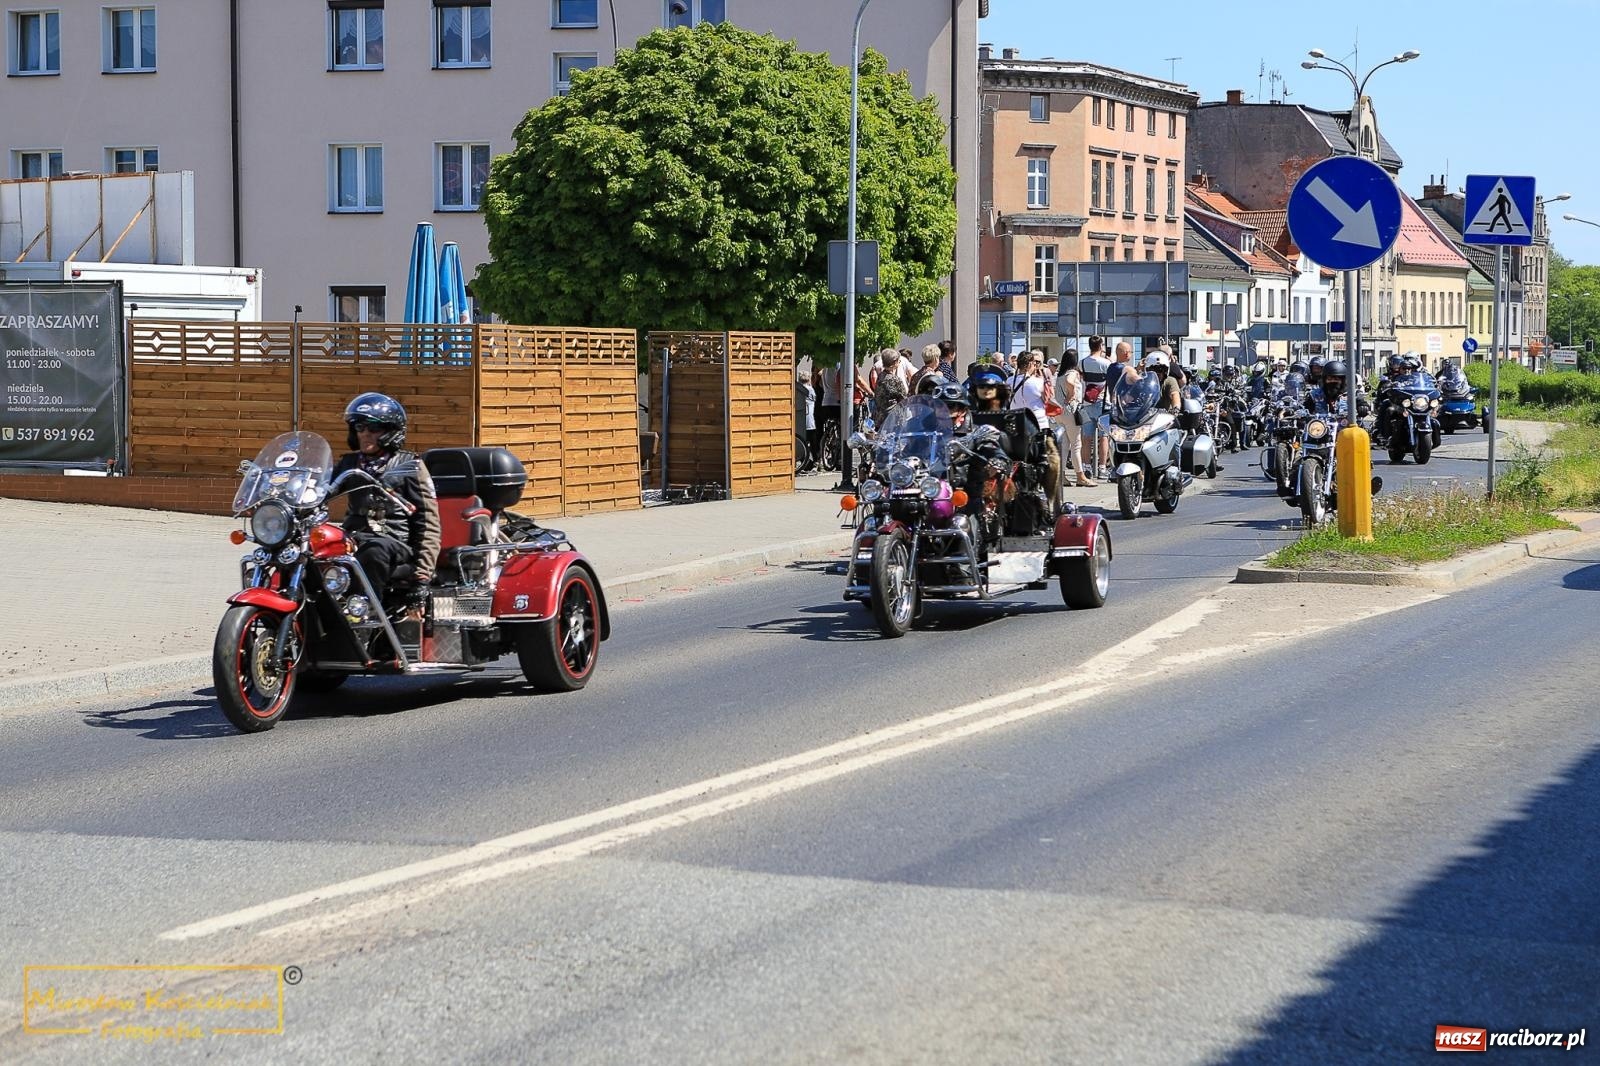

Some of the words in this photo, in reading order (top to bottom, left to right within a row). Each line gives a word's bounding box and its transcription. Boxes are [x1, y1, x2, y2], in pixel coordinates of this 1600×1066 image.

[0, 315, 99, 329] ZAPRASZAMY!
[6, 347, 59, 358] poniedziałek
[66, 348, 96, 357] sobota
[6, 360, 31, 369] 11.00
[37, 360, 62, 369] 23.00
[7, 383, 44, 393] niedziela
[7, 395, 31, 405] 15.00
[38, 395, 63, 405] 22.00
[16, 428, 41, 441] 537
[43, 428, 67, 441] 891
[70, 428, 95, 441] 962
